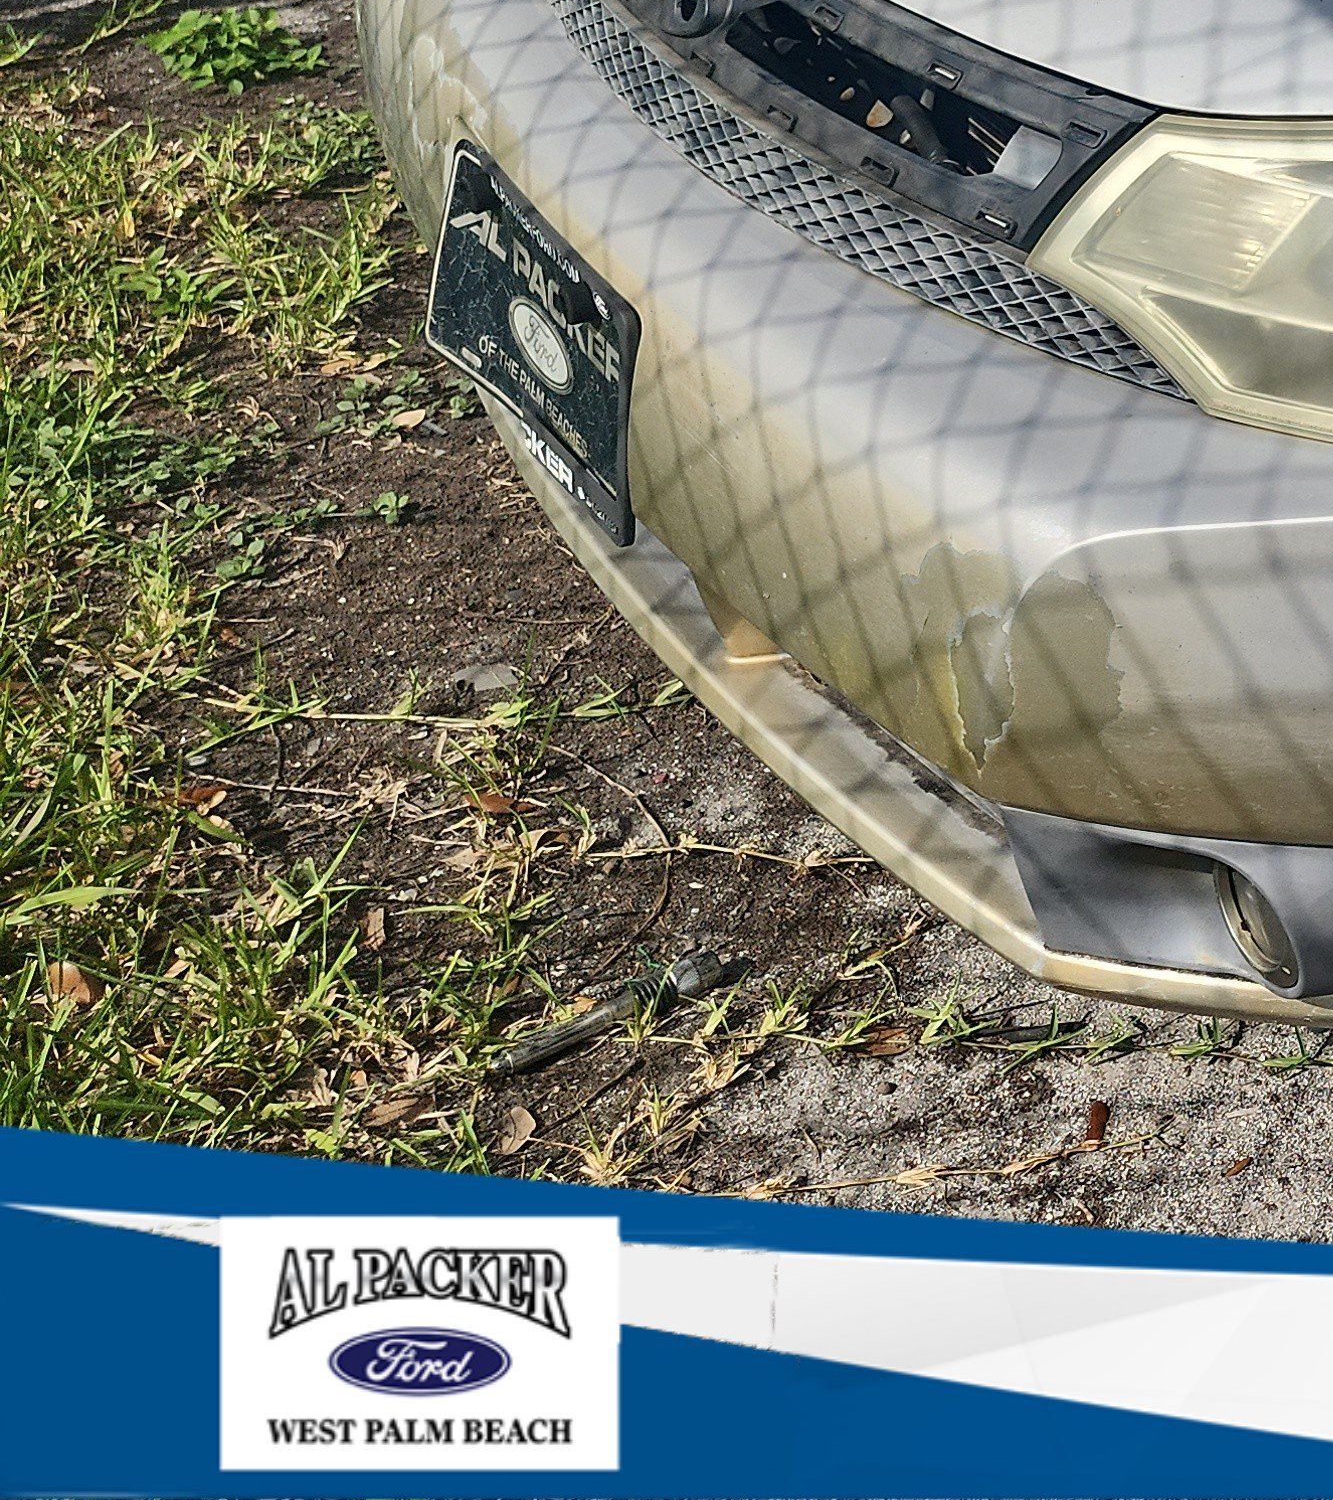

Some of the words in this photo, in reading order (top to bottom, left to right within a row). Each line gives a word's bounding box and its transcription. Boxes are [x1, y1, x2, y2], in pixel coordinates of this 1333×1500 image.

[450, 209, 507, 263] AL
[523, 314, 558, 373] Ford
[478, 334, 498, 358] OF
[499, 348, 520, 379] THE
[519, 369, 545, 410] PALM
[545, 398, 589, 458] BEACHES
